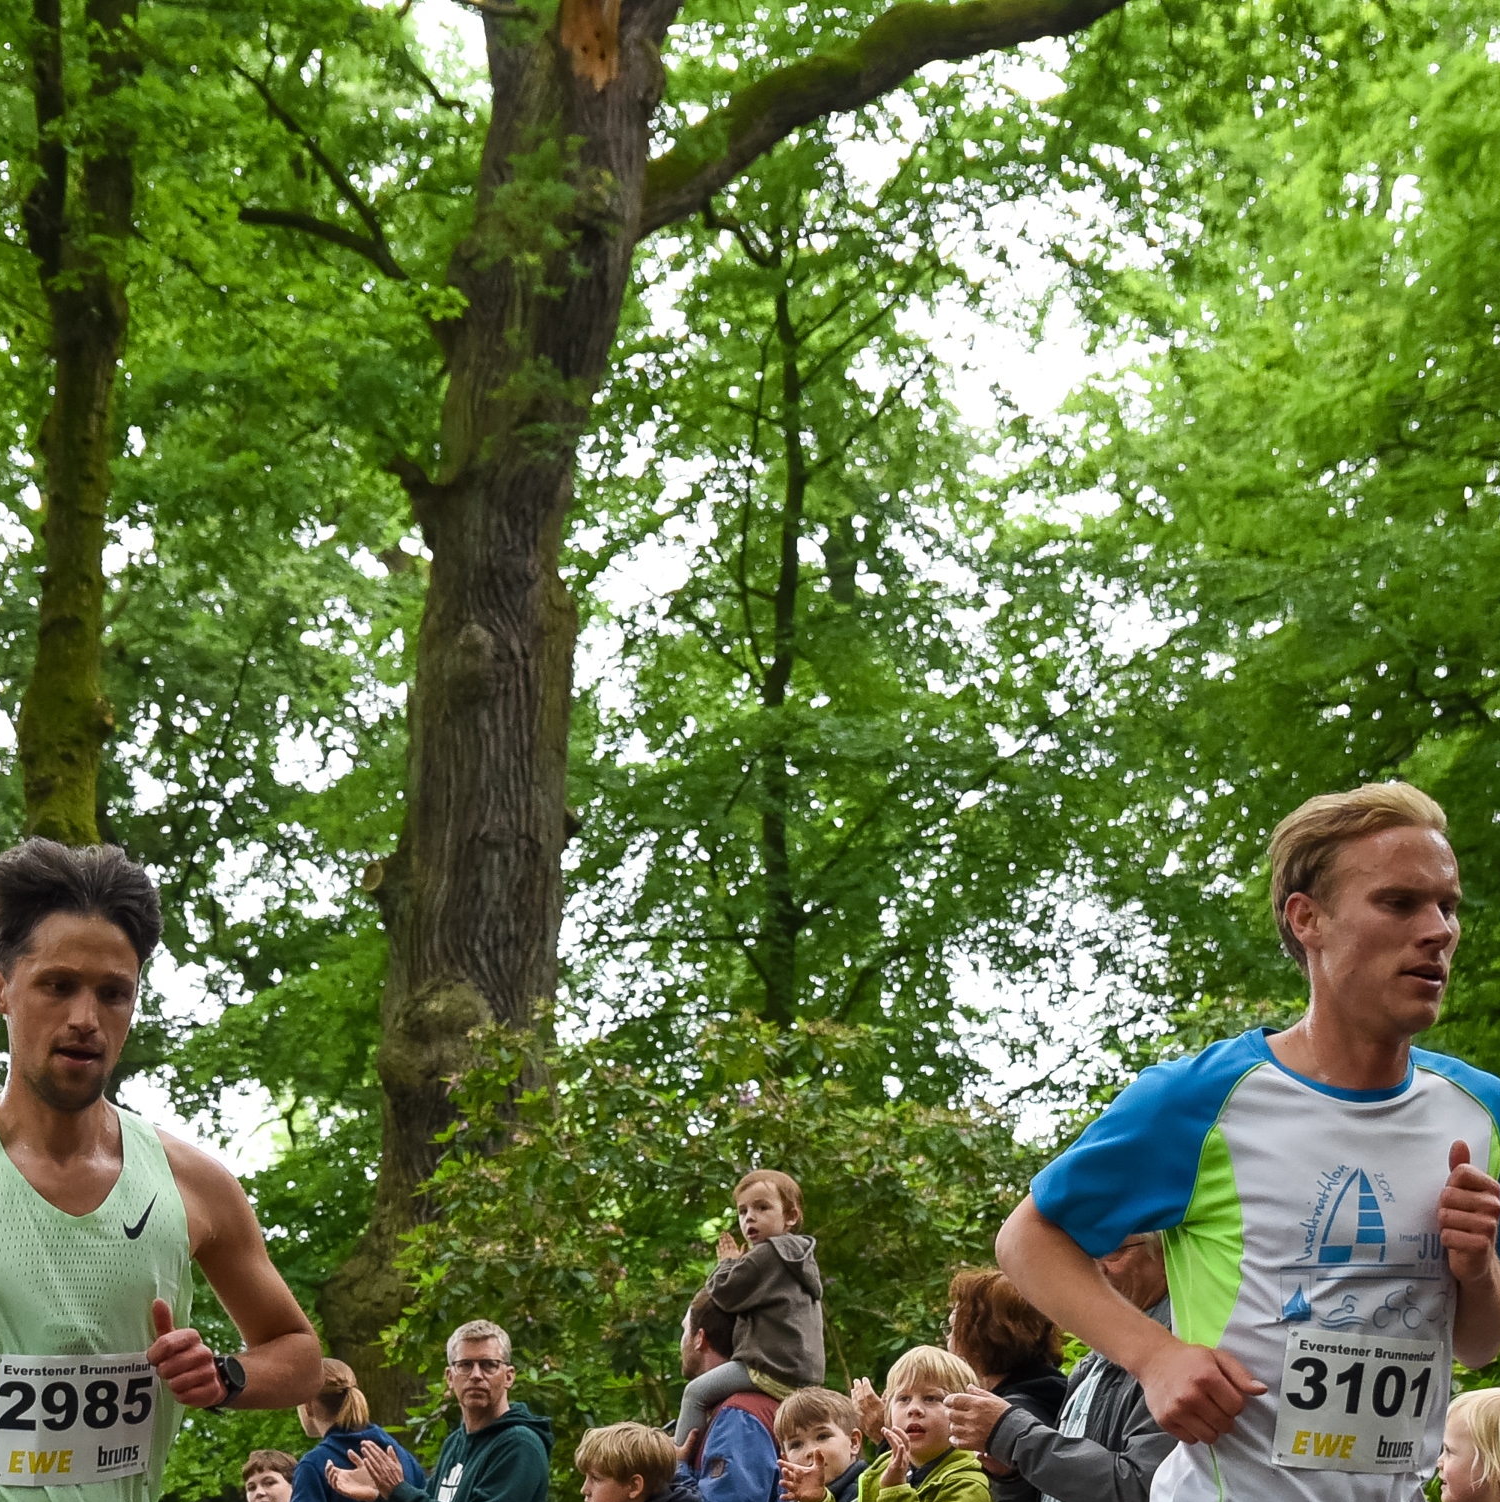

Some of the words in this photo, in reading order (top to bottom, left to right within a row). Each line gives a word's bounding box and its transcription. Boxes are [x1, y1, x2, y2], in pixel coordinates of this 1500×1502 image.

[1299, 1339, 1371, 1357] Everstener
[1374, 1347, 1436, 1362] Brunnenlauf
[3, 1364, 76, 1376] Everstener
[79, 1362, 151, 1375] Brunnenlauf
[1286, 1356, 1432, 1418] 3101
[8, 1450, 73, 1474] EWE
[98, 1444, 140, 1467] bruns
[1291, 1430, 1357, 1459] EWE
[1376, 1435, 1414, 1458] bruns
